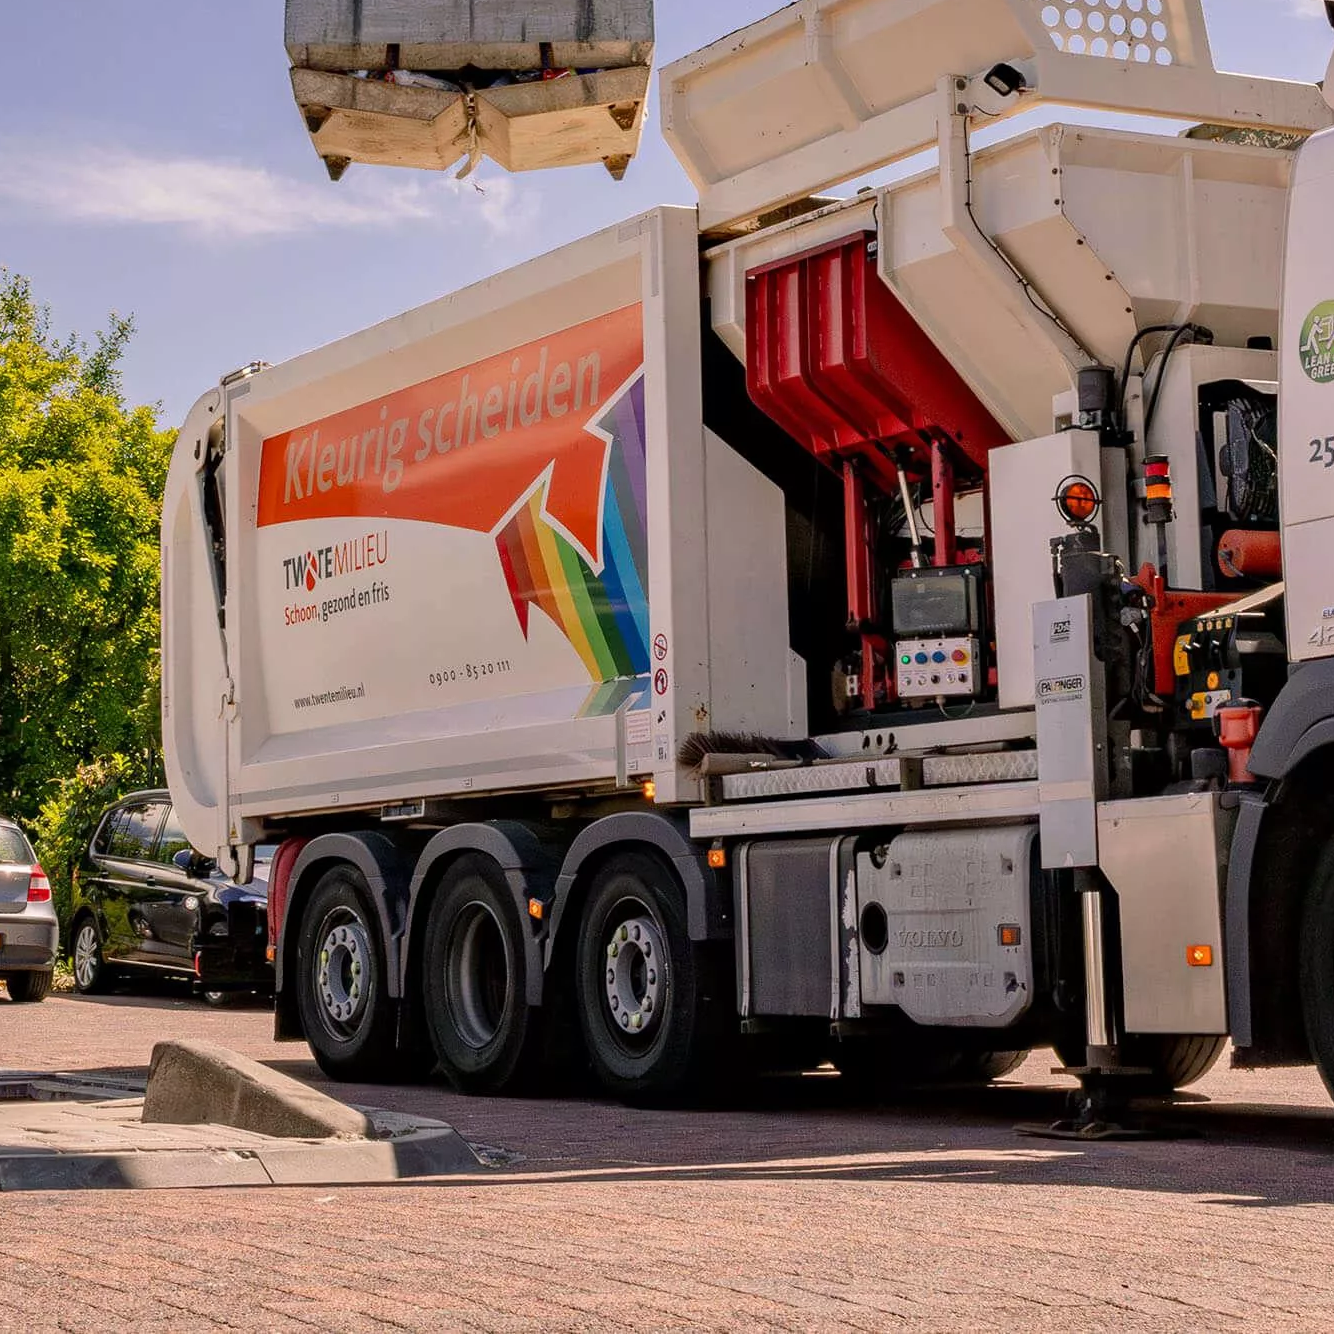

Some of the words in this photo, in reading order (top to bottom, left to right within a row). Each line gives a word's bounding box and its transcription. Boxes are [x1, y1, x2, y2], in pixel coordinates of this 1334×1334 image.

[1304, 352, 1330, 369] LEAN
[283, 404, 410, 505] Kleurig
[414, 345, 602, 462] scheiden
[284, 604, 321, 626] Schoon,
[322, 588, 356, 622] gezond
[358, 589, 371, 607] en
[373, 581, 390, 604] fris
[429, 669, 457, 686] 0900
[465, 663, 479, 680] 85
[481, 662, 494, 675] 20
[293, 681, 366, 709] www.twentemilieu.nl
[899, 930, 964, 948] VOLVO
